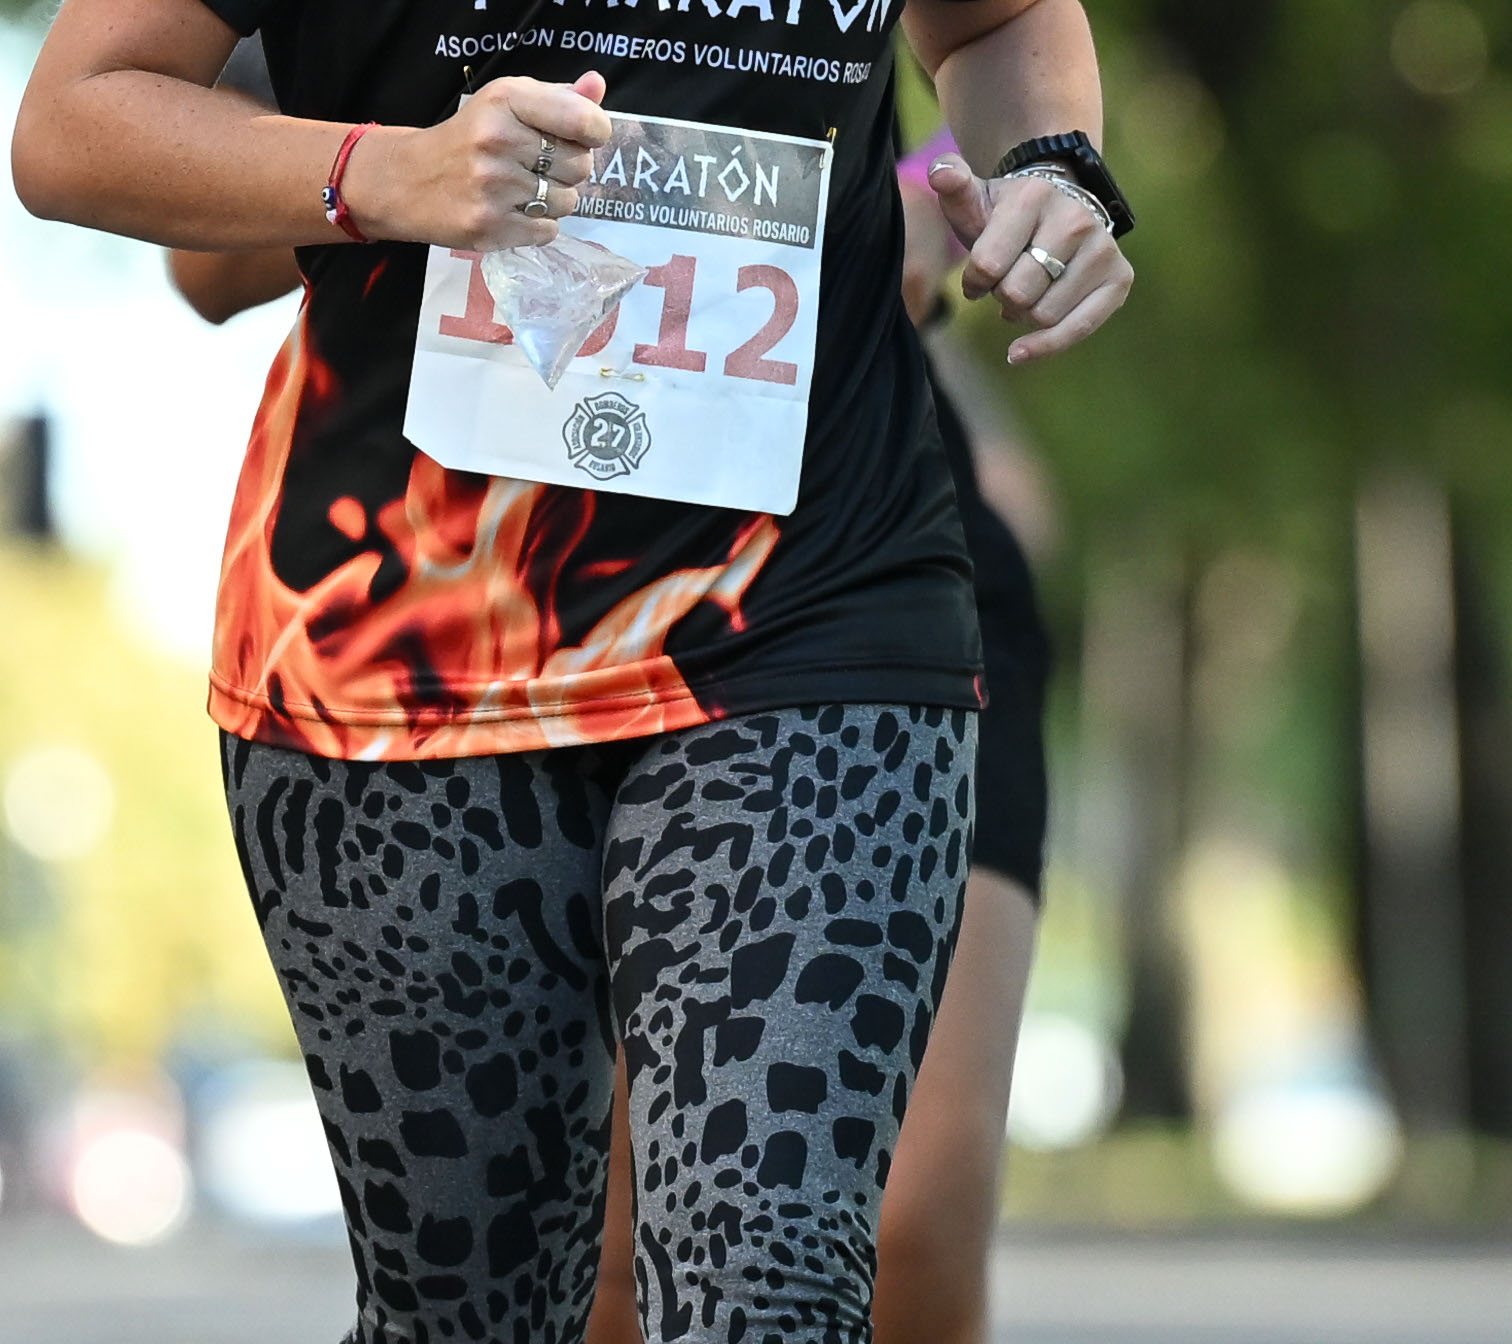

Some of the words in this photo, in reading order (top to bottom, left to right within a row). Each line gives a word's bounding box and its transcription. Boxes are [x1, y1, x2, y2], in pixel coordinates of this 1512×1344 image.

[560, 30, 686, 63] BOMBEROS
[693, 44, 840, 83] VOLUNTARIOS
[589, 144, 780, 207] ARATÓN
[573, 196, 645, 222] OMBEROS
[649, 205, 749, 235] VOLUNTARIOS
[752, 218, 810, 244] ROSARIO
[438, 241, 799, 386] 112
[591, 417, 625, 448] 27
